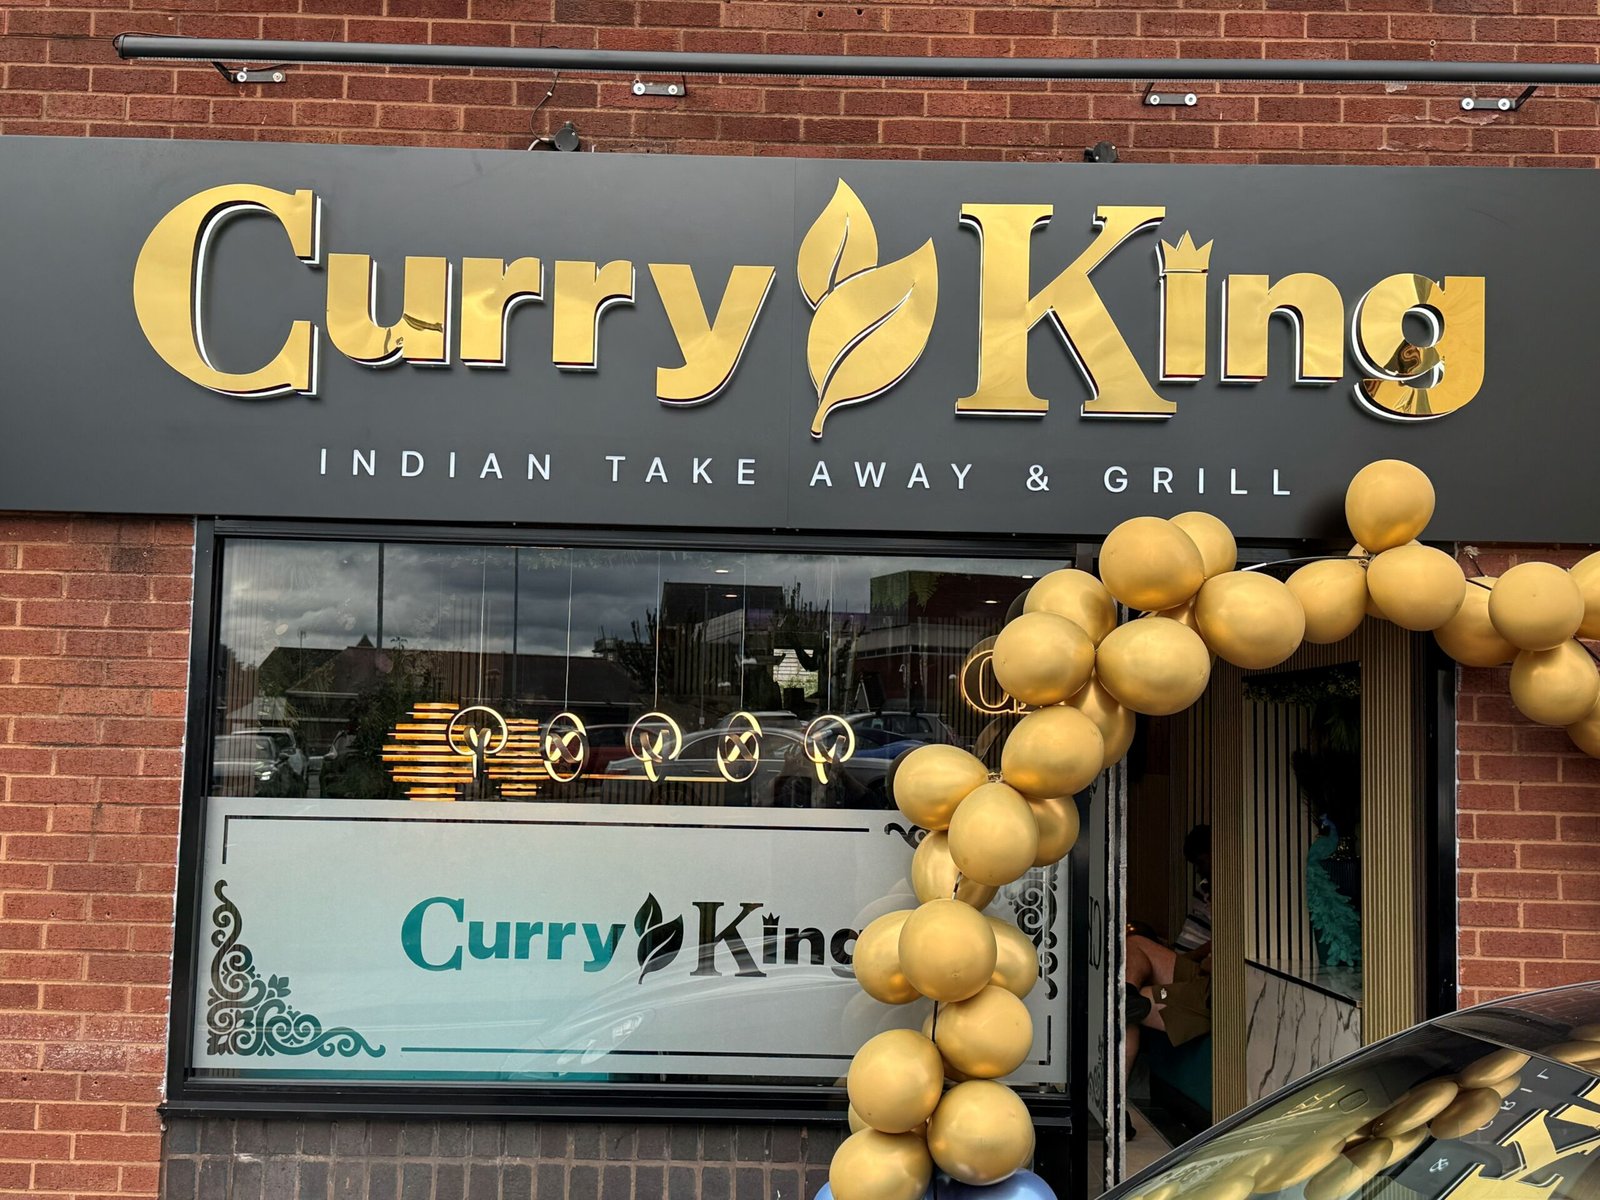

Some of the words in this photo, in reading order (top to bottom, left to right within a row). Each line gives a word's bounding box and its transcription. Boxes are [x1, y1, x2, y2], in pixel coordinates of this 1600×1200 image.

[133, 183, 777, 408] Curry
[955, 203, 1488, 422] King
[320, 448, 551, 480] INDIAN
[605, 455, 756, 485] TAKE
[809, 460, 972, 490] AWAY
[1026, 464, 1050, 492] &
[1103, 465, 1291, 496] GRILL
[400, 896, 627, 973] Curry
